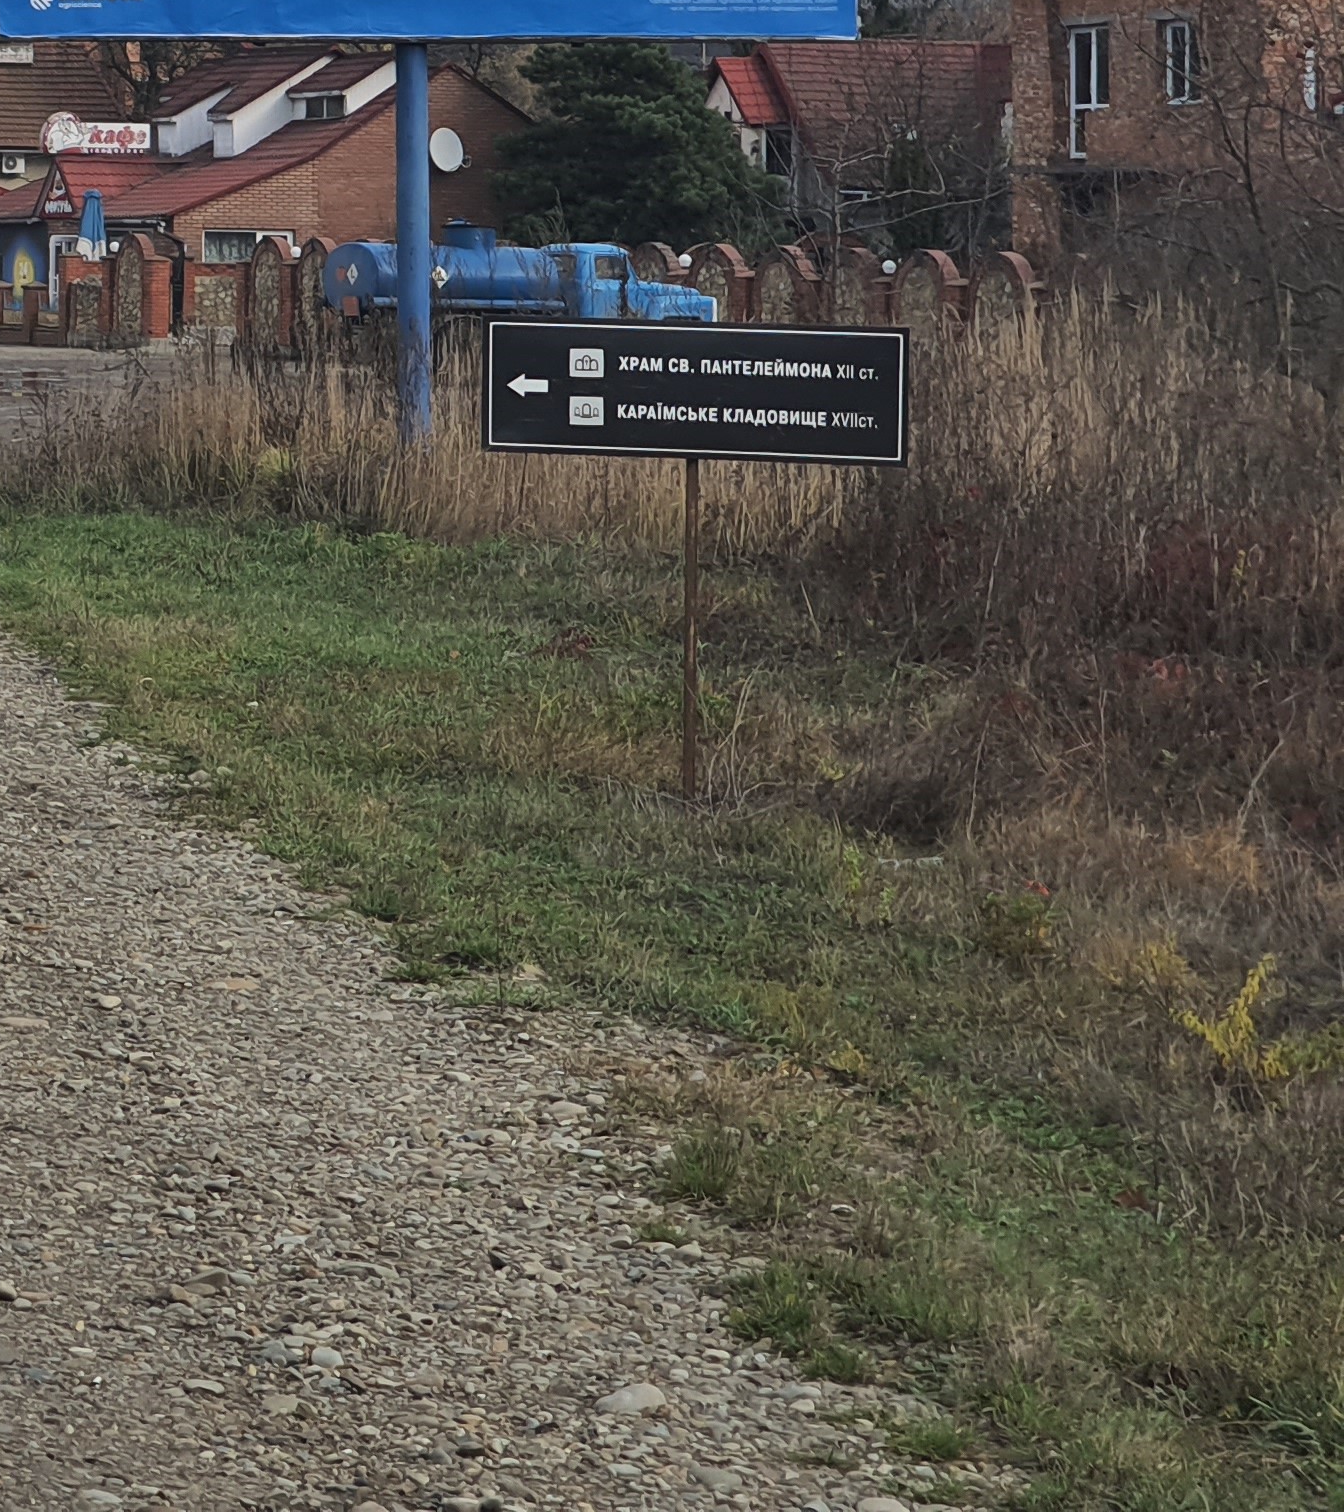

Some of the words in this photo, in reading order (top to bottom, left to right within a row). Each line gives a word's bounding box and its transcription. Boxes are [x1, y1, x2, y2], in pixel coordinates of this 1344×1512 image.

[88, 125, 147, 148] кафе
[618, 356, 663, 373] ХРАМ
[668, 358, 695, 374] СВ.
[700, 357, 832, 379] ПАНТЕЛЕЙМОНА
[836, 364, 855, 380] XII
[858, 368, 879, 381] ст.
[617, 401, 718, 423] КАРАЇМСЬКЕ
[722, 407, 827, 429] КЛАДОВИЩЕ
